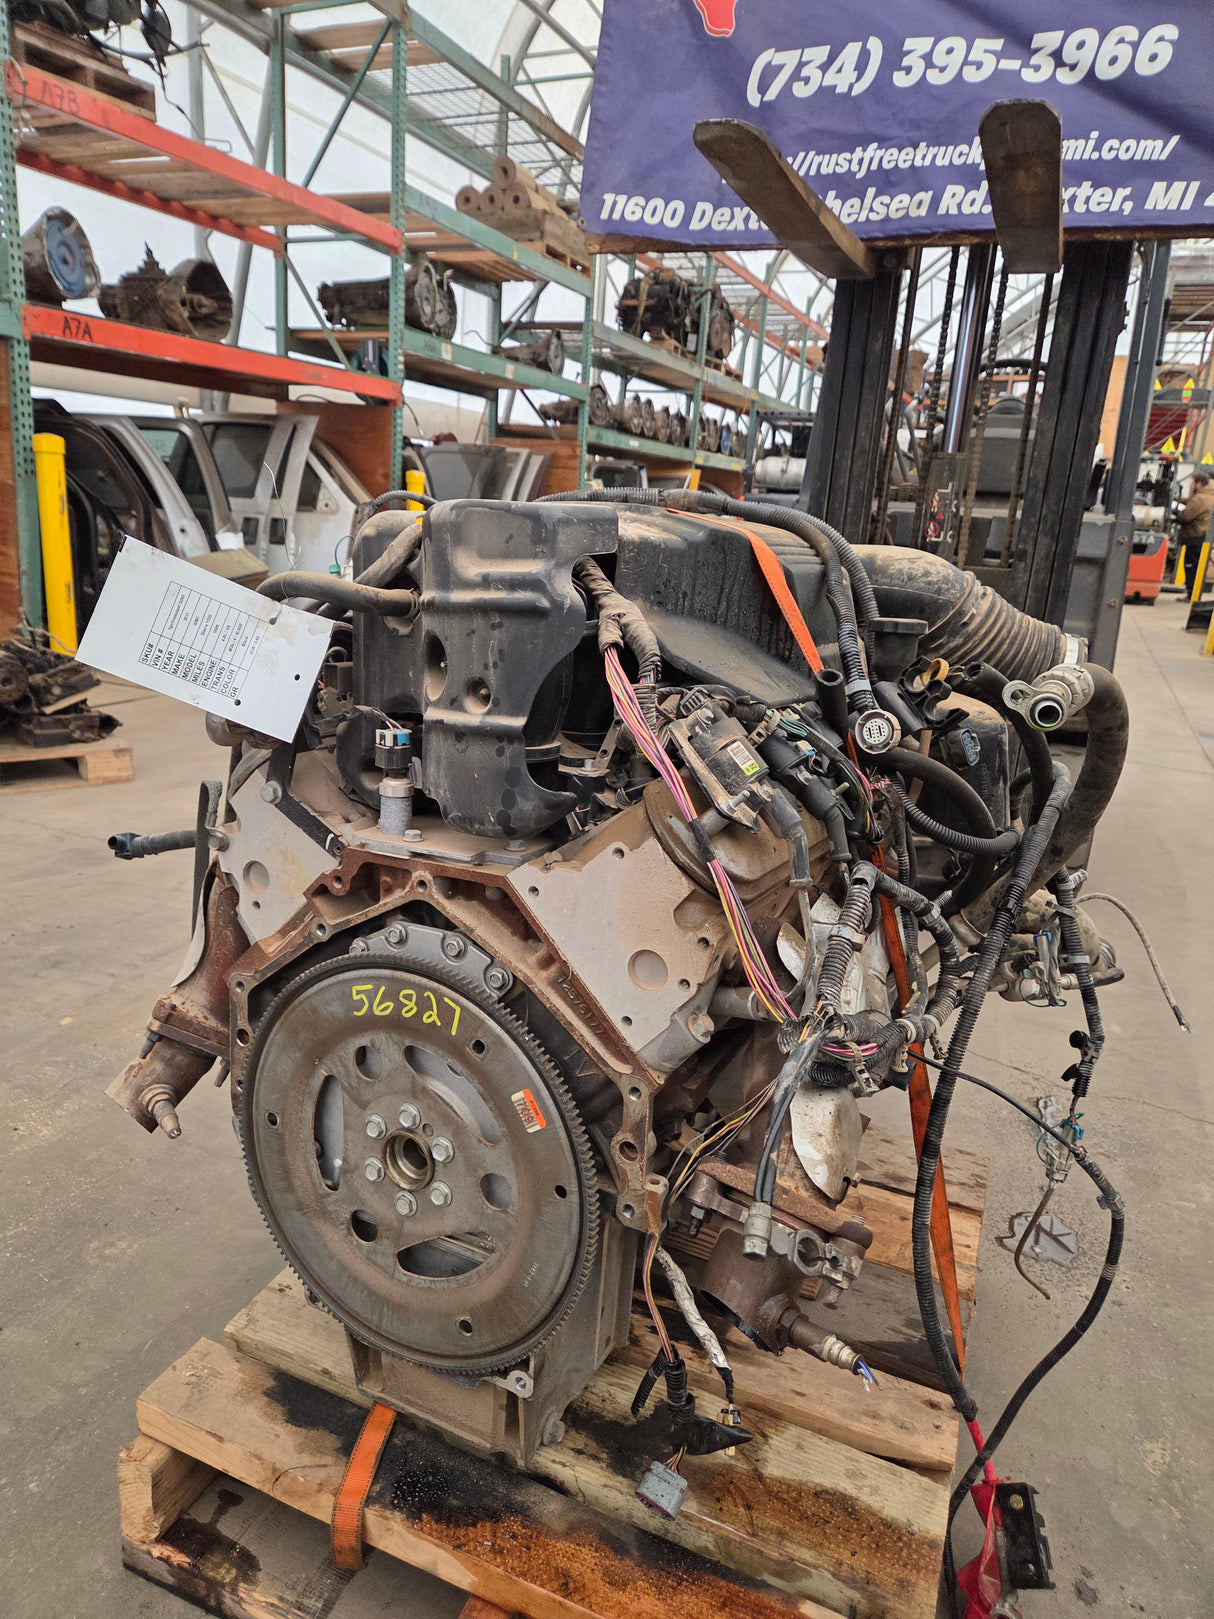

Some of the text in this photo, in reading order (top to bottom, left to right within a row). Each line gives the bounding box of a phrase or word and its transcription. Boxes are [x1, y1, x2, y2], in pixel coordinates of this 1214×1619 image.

[747, 24, 1179, 107] (734) 395-3966
[600, 193, 685, 228] 11600
[689, 201, 770, 232] Dext
[819, 187, 933, 224] helsea
[937, 180, 993, 214] Rd.
[1061, 181, 1133, 215] xter,
[1144, 181, 1201, 210] MI
[63, 316, 93, 342] A7A
[141, 642, 153, 663] SKU#
[151, 654, 161, 666] VIN
[161, 650, 174, 670] YEAR
[171, 653, 185, 675] MAKE
[181, 654, 197, 679] MODEL
[191, 660, 205, 682] MILES
[201, 659, 216, 687] ENGINE
[210, 667, 225, 689] TRANS
[220, 669, 235, 694] COLOR
[229, 686, 239, 697] GR
[352, 984, 461, 1036] 56827
